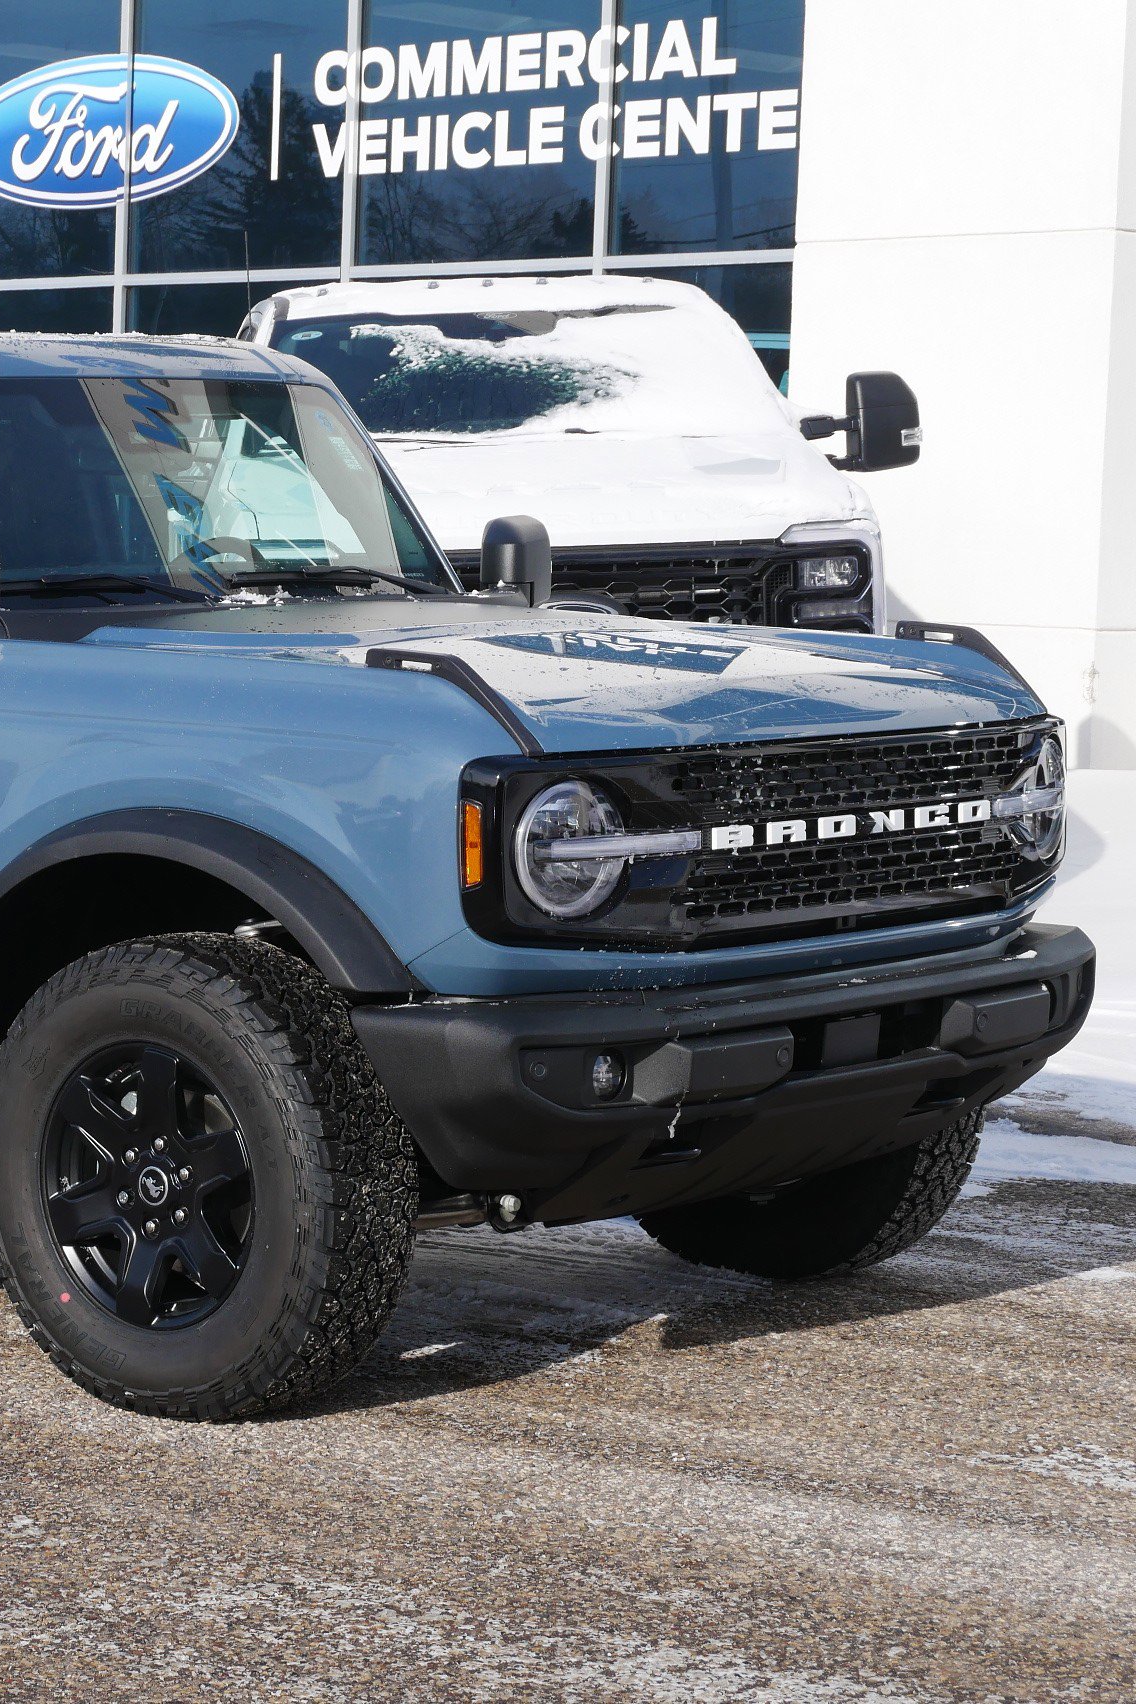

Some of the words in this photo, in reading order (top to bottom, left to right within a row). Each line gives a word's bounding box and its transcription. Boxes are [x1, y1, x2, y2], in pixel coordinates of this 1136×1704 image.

[314, 17, 737, 106] COMMERCIAL
[11, 80, 180, 182] Ford
[312, 105, 565, 178] VEHICLE
[579, 88, 799, 161] CENTE
[711, 800, 991, 851] BRONCO
